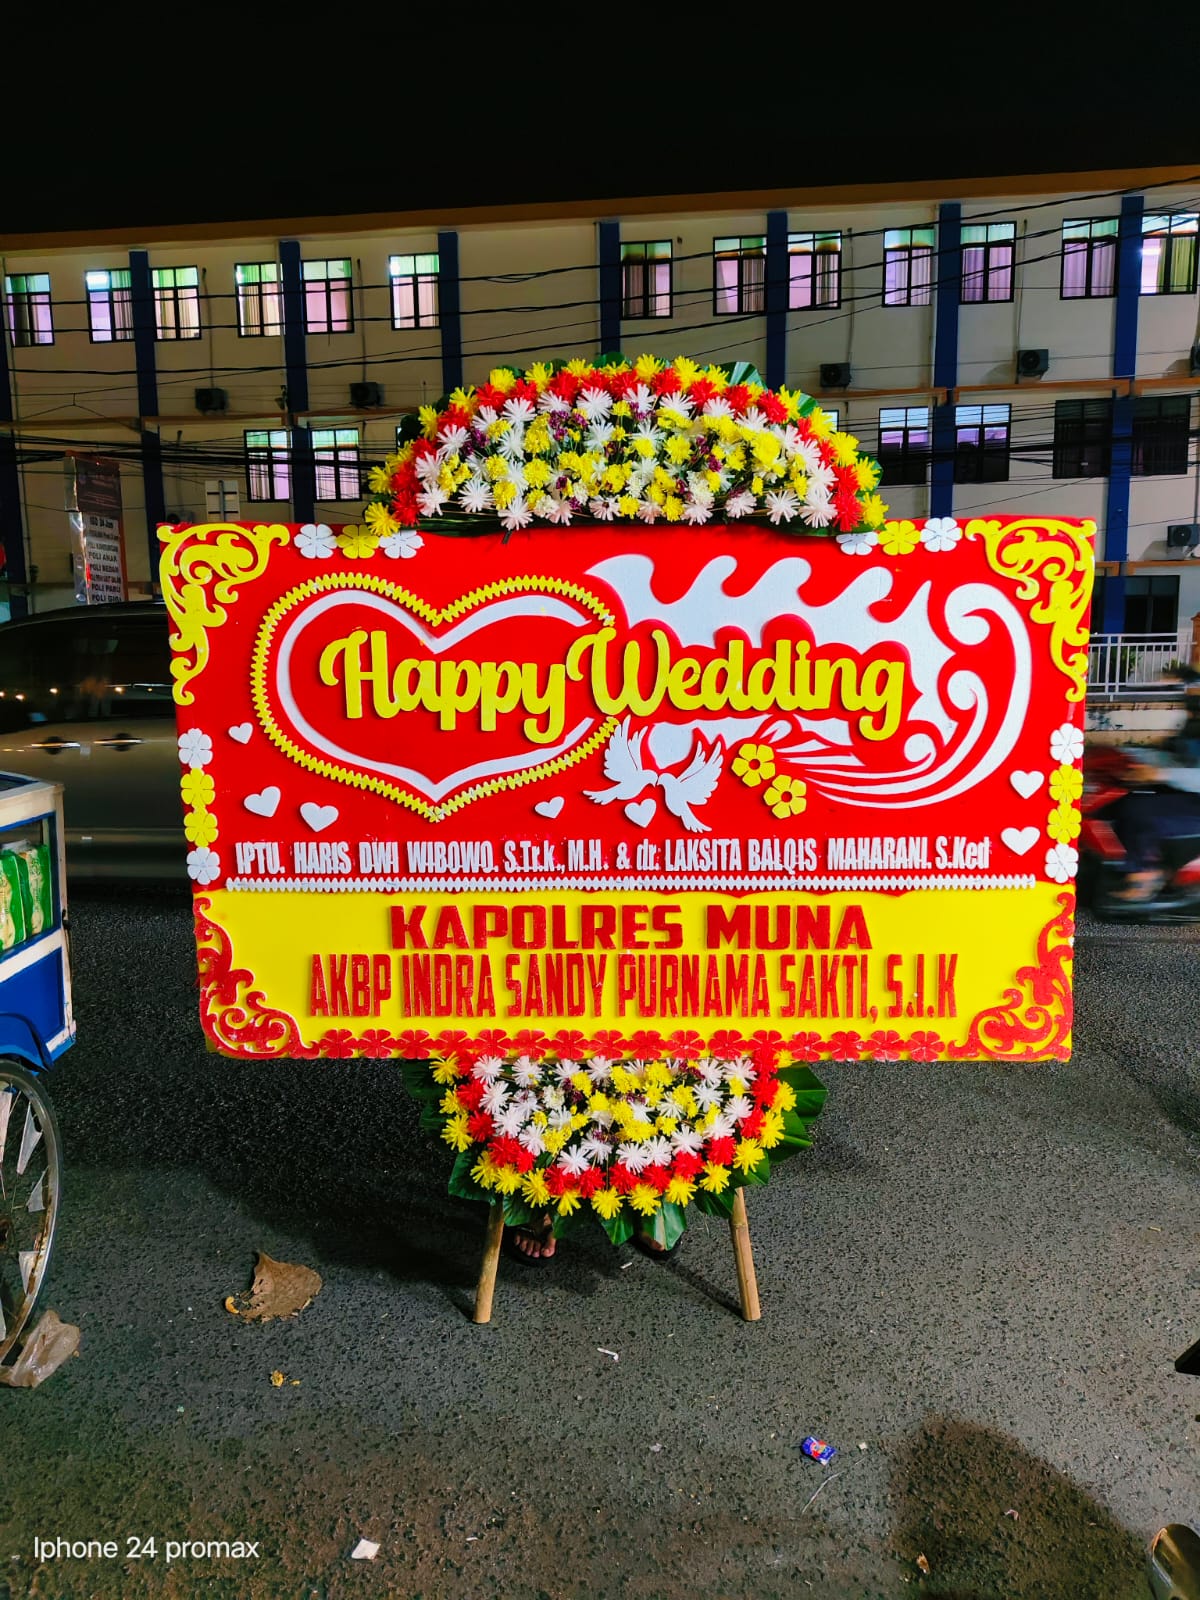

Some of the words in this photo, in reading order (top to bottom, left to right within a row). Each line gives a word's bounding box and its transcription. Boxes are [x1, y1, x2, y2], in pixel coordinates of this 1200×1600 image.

[320, 630, 566, 744] Happy
[566, 627, 905, 740] Wedding
[235, 841, 286, 875] IPTU.
[293, 841, 352, 875] HARIS
[358, 841, 400, 874] DWI
[406, 840, 499, 874] WIBOWO.
[567, 838, 610, 872] M.H.
[616, 842, 632, 871] &
[665, 838, 743, 872] LAKSITA
[748, 837, 817, 876] BALQIS
[935, 835, 991, 870] S.Ked
[390, 904, 683, 949] KAPOLRES
[706, 904, 873, 949] MUNA
[310, 954, 392, 1017] AKBP
[401, 953, 497, 1017] INDRA
[505, 953, 608, 1018] SANDY
[617, 953, 771, 1018] PURNAMA
[780, 953, 879, 1024] SAKTI,
[887, 953, 959, 1018] S.I.K
